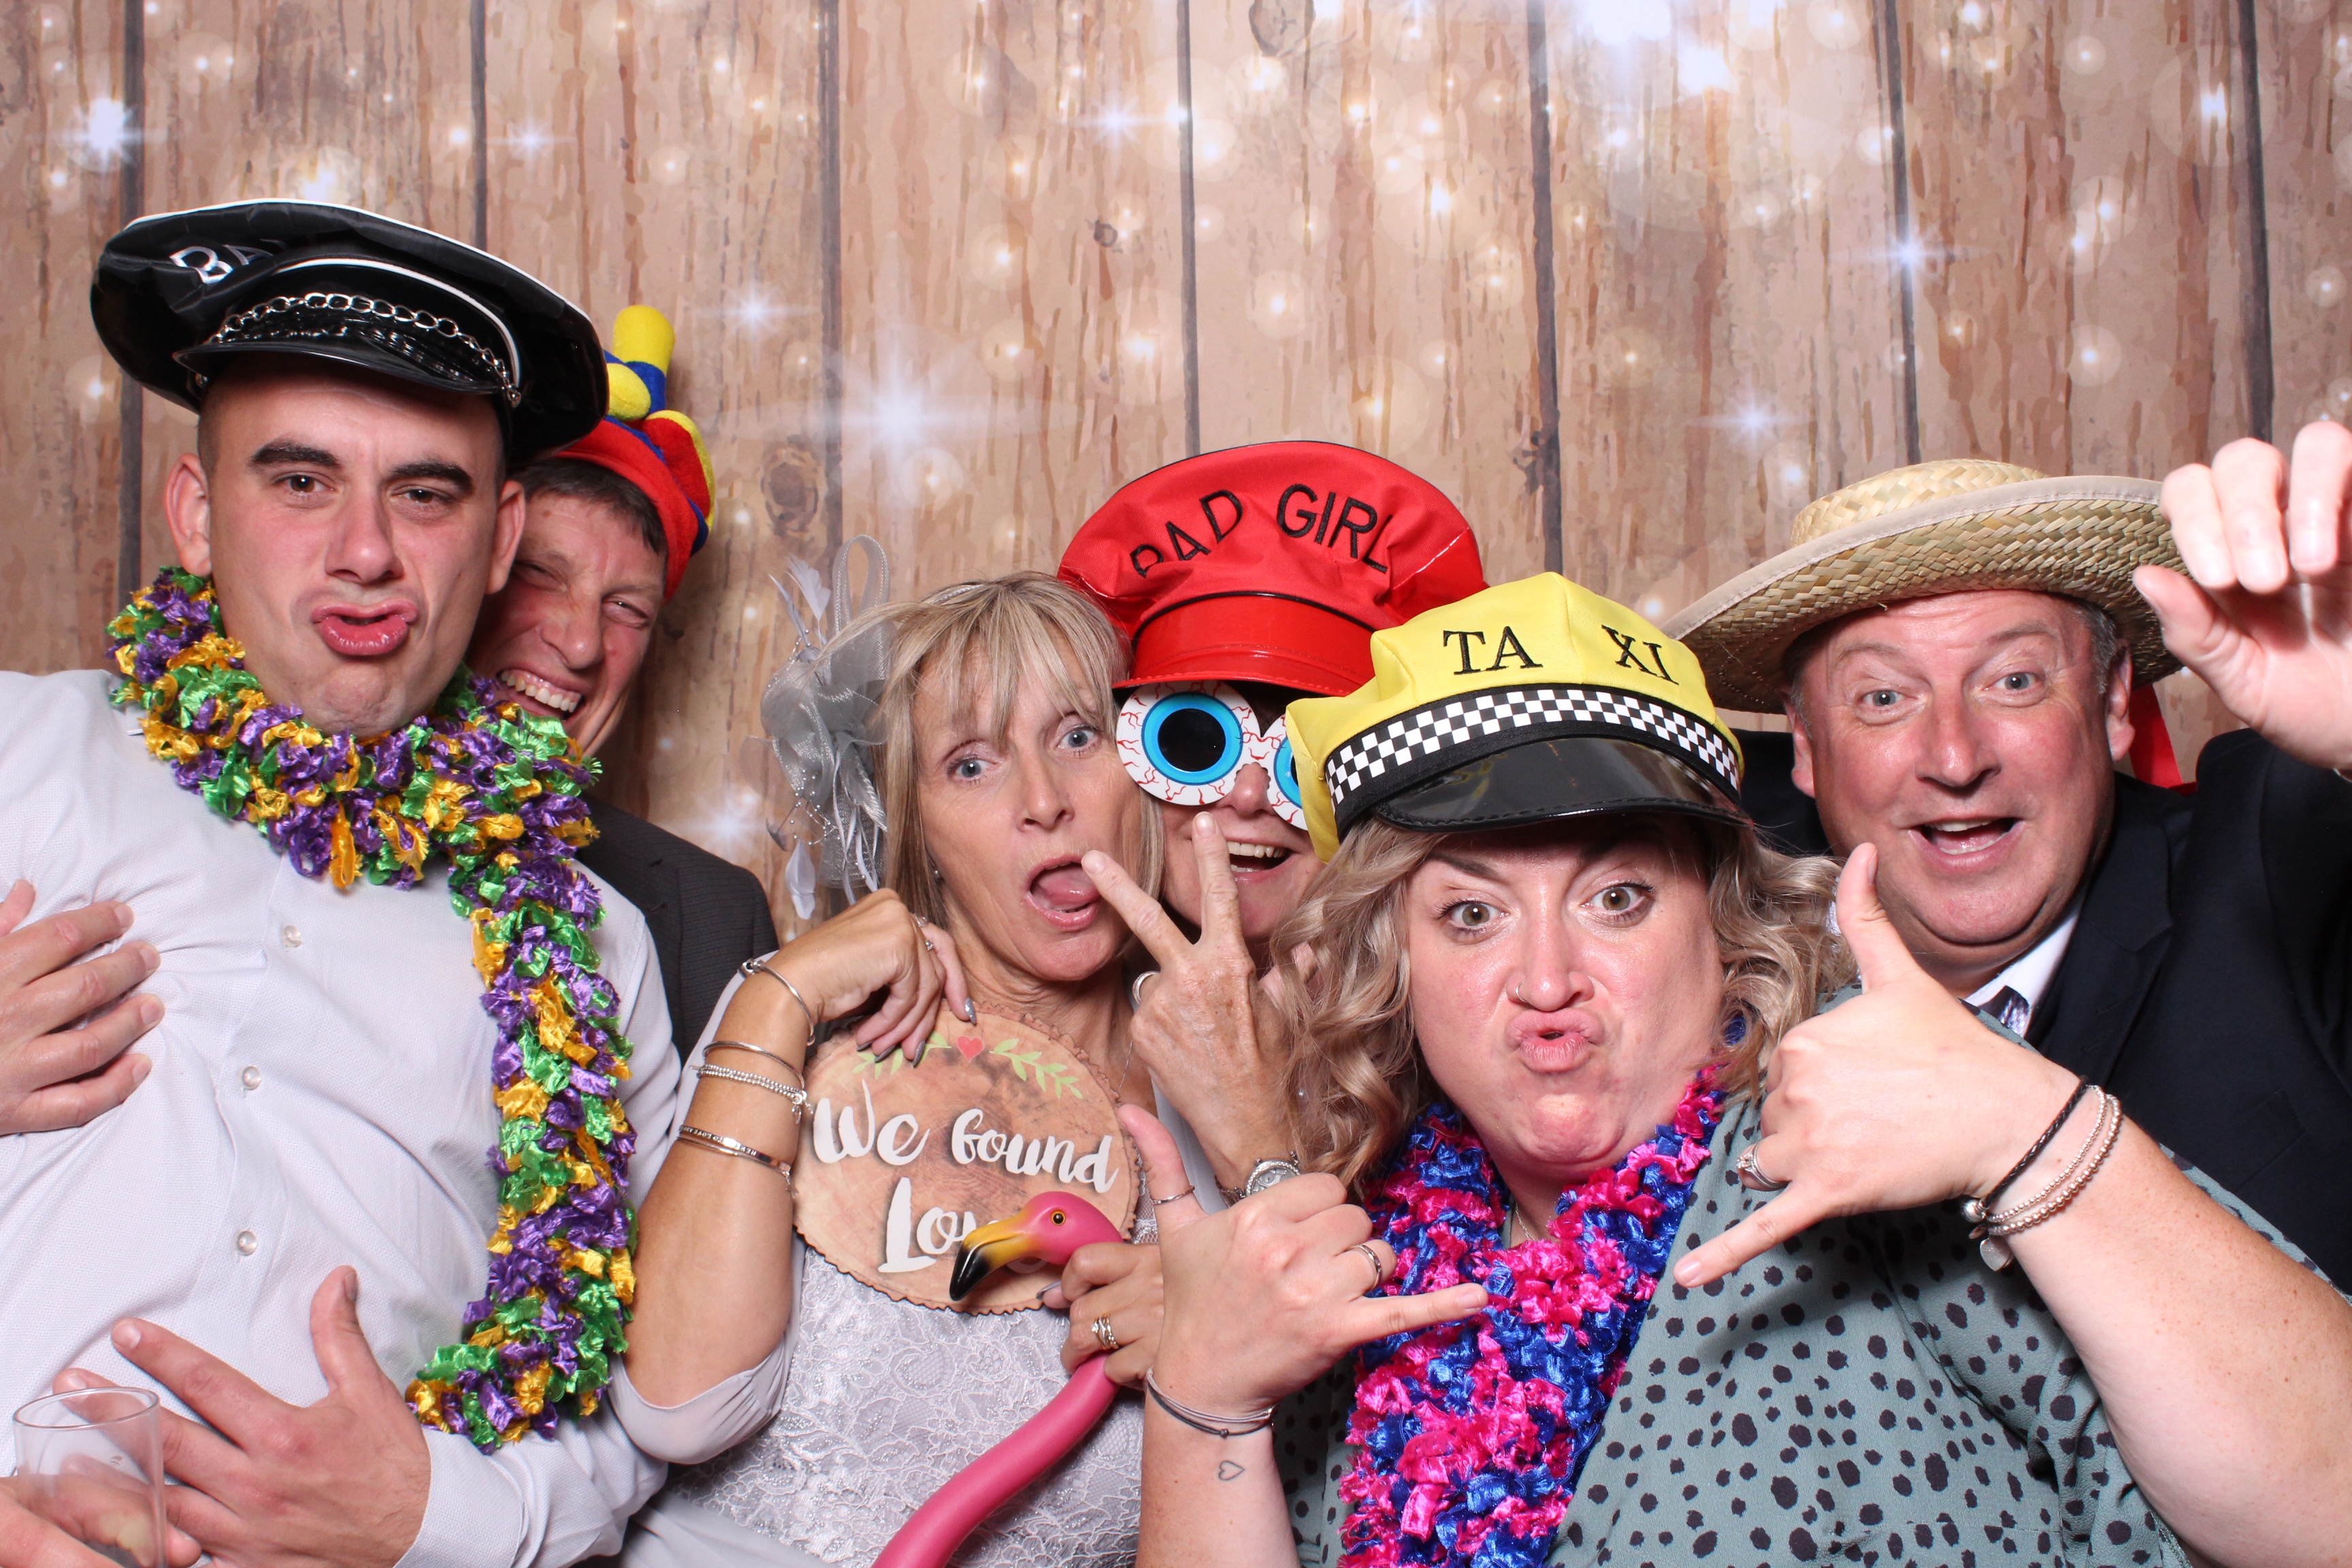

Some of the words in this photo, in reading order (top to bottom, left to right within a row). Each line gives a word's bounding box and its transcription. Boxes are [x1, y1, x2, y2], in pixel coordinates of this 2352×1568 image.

[169, 239, 283, 284] BA
[1277, 483, 1393, 574] GIRL
[693, 1128, 713, 1139] LOVE
[813, 1078, 930, 1165] We
[951, 1107, 1120, 1194] found
[877, 1176, 1047, 1274] Lo
